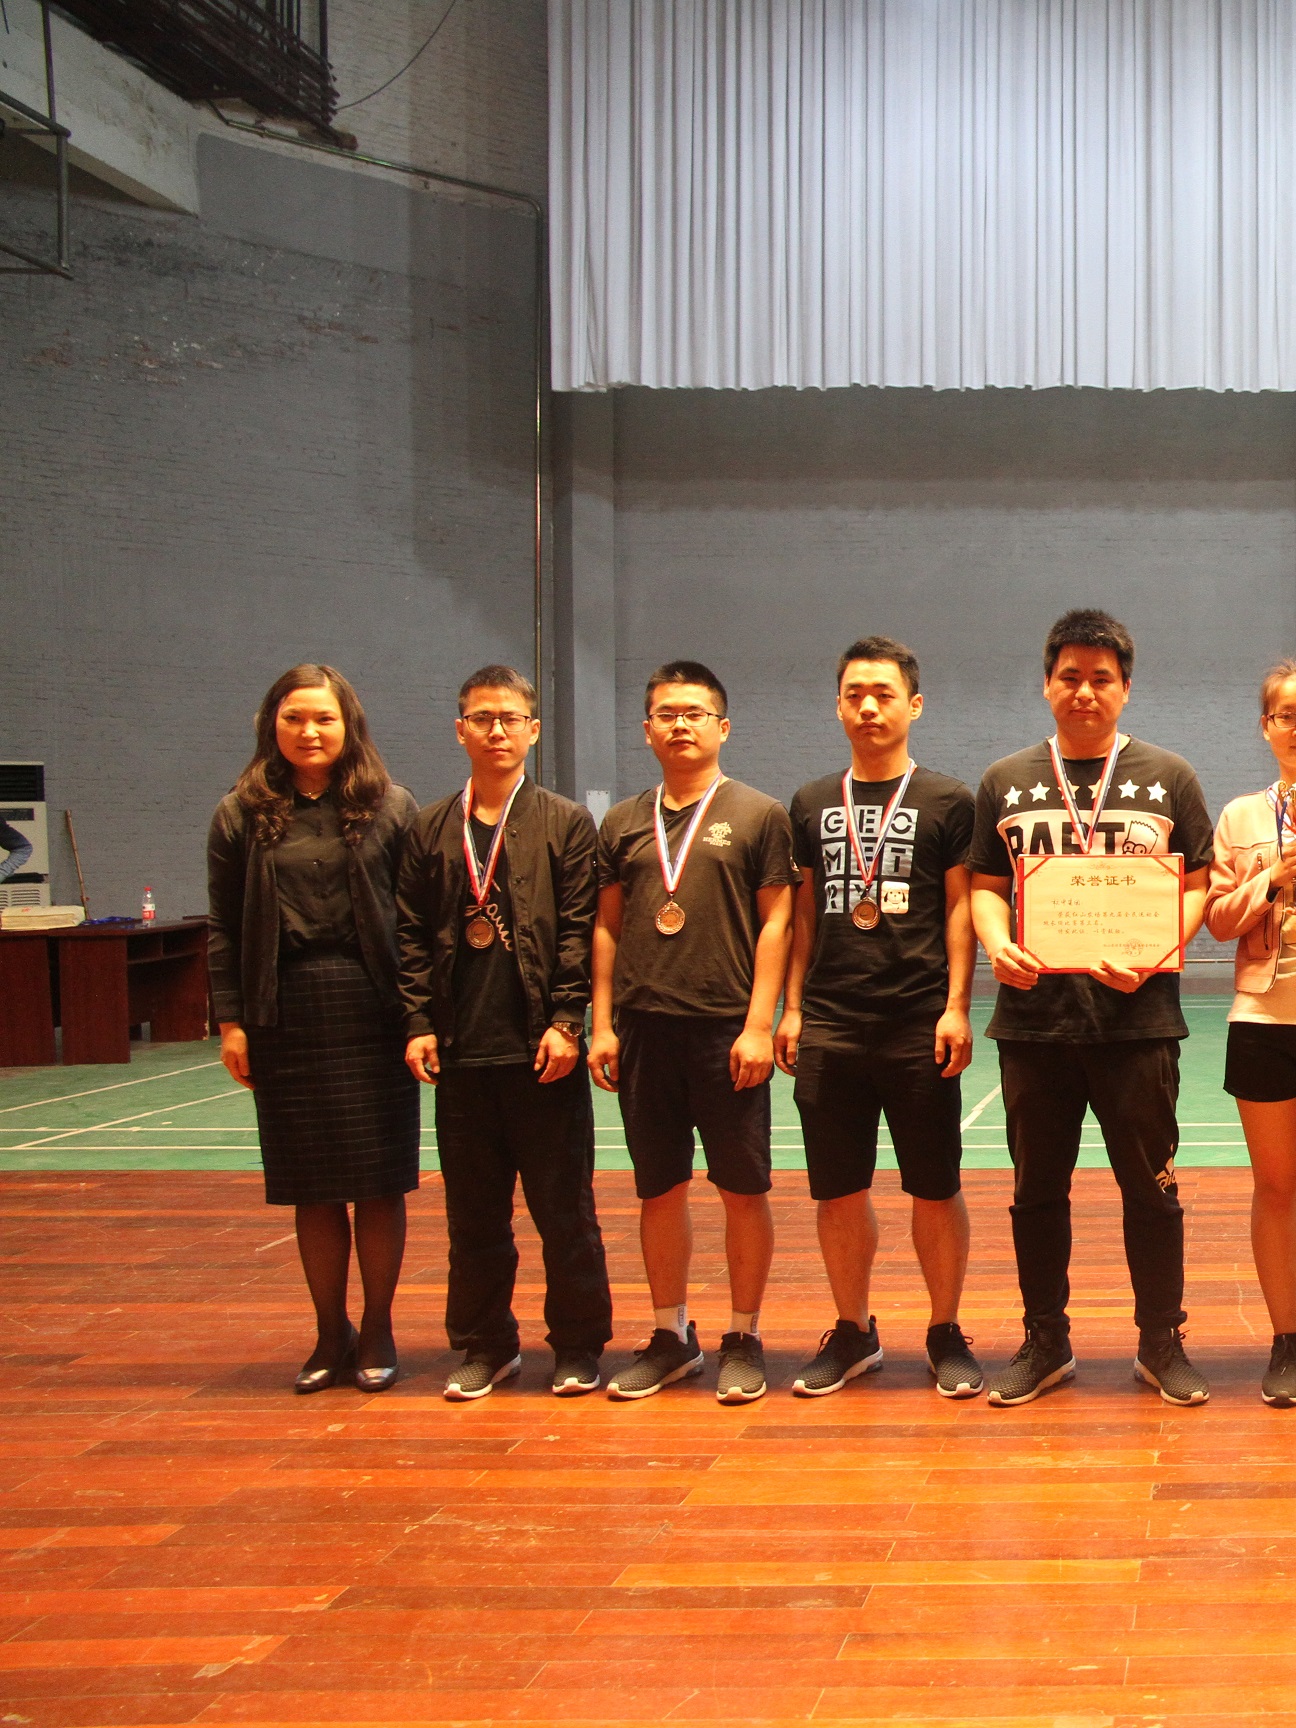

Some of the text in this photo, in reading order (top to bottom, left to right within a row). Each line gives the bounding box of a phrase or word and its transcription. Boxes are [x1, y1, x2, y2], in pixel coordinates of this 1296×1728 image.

[824, 809, 913, 834] GEO
[1070, 875, 1136, 886] 荣誉证书
